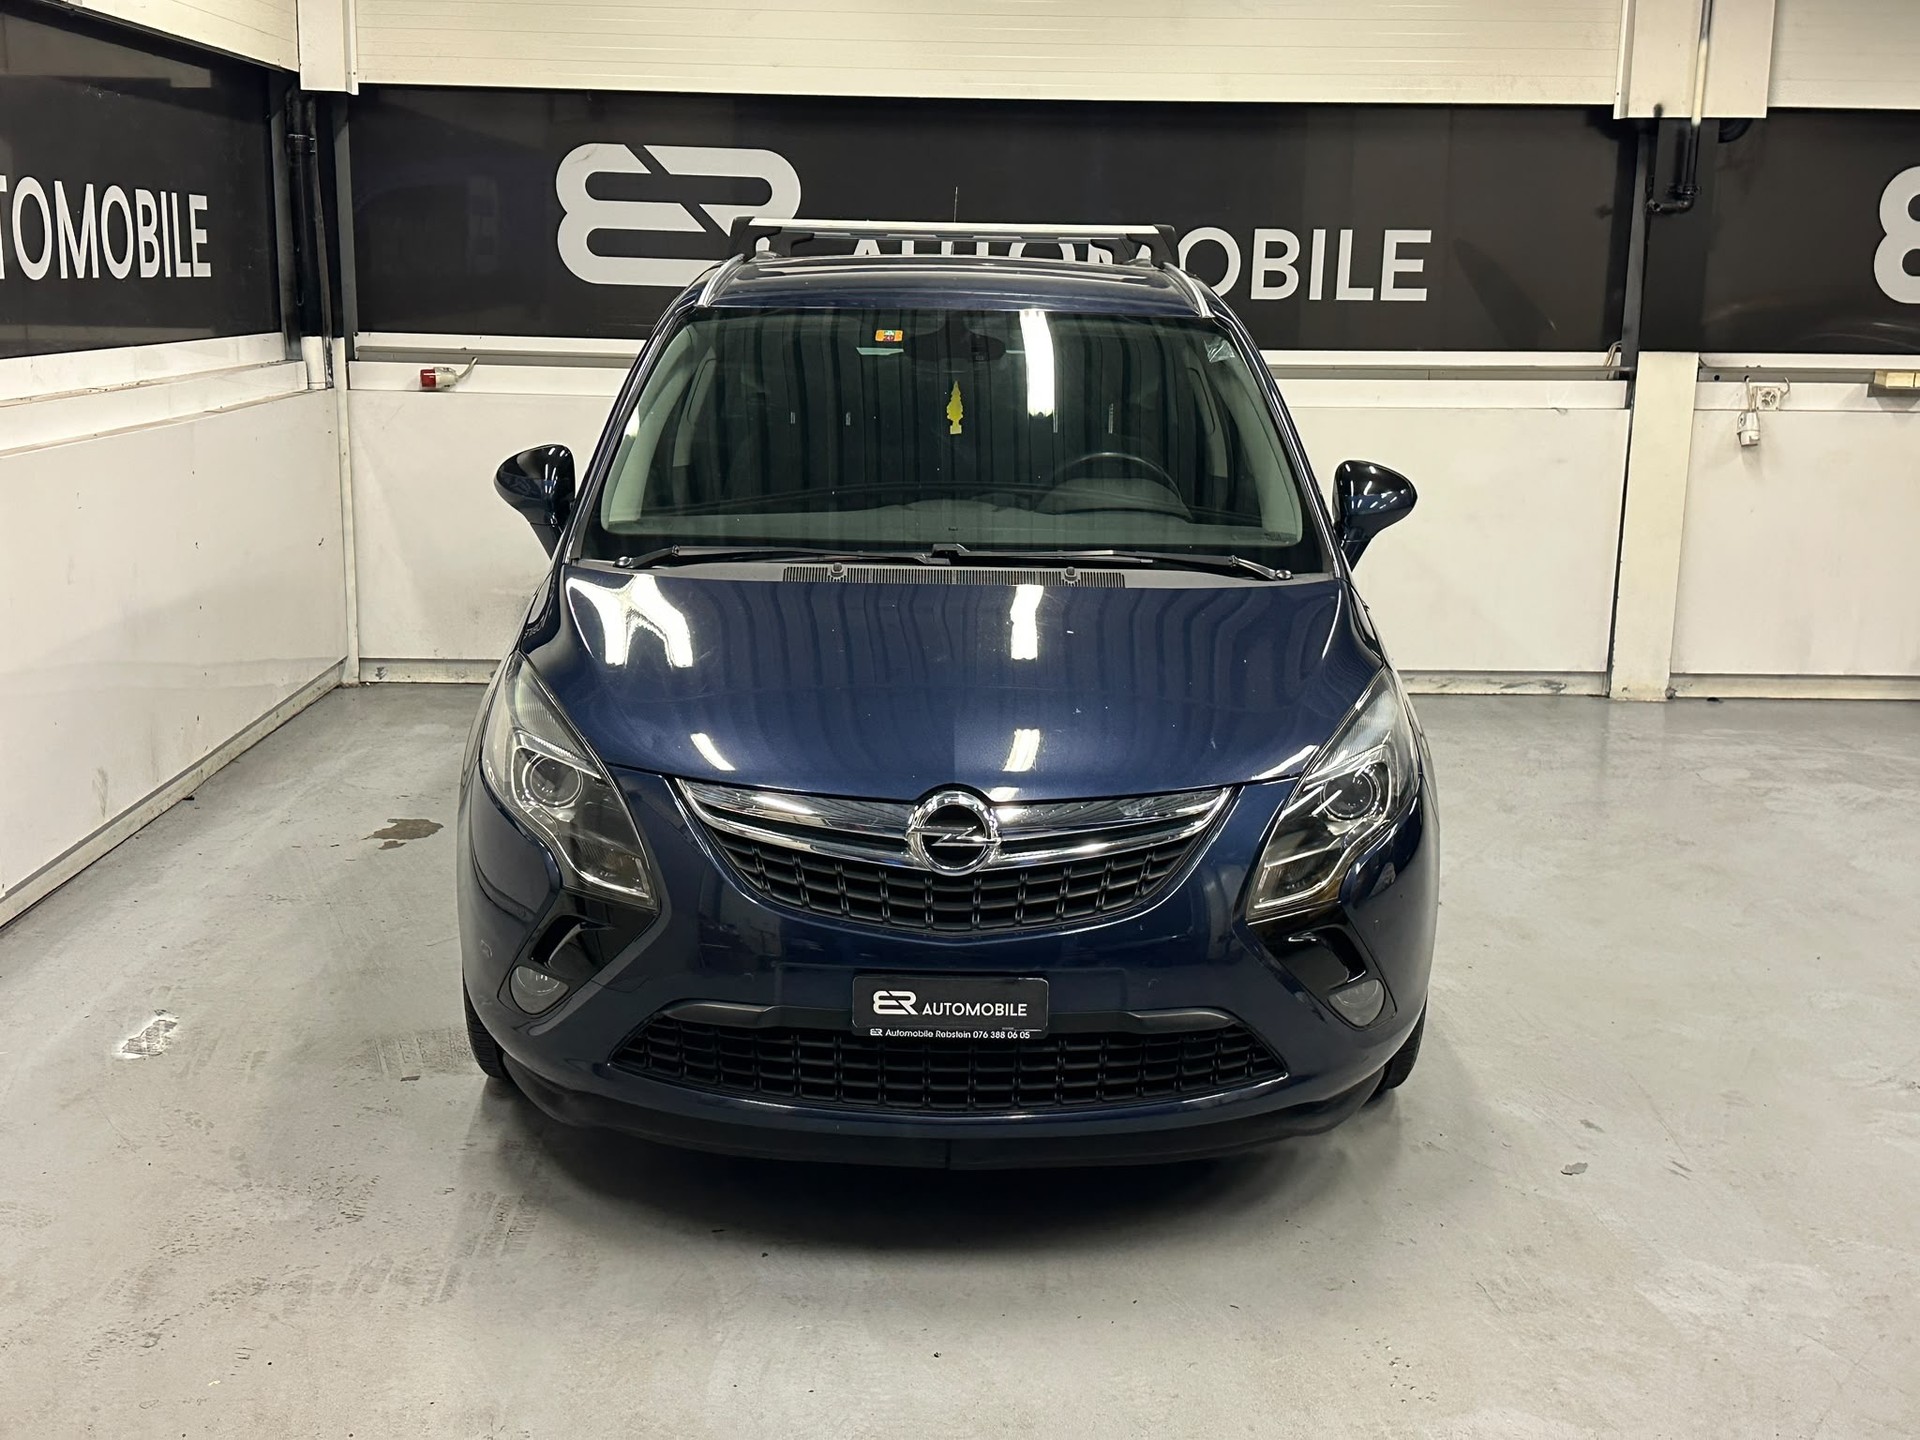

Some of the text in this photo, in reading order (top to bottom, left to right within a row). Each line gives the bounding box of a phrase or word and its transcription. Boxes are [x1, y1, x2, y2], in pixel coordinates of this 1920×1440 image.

[853, 226, 1432, 301] OBILE
[873, 991, 1027, 1016] ER AUTOMOBILE
[870, 1028, 883, 1037] ER
[885, 1029, 934, 1038] Automobile
[972, 1030, 988, 1039] 076
[990, 1031, 1006, 1039] 388
[1007, 1031, 1018, 1039] 06
[1019, 1031, 1031, 1039] 05
